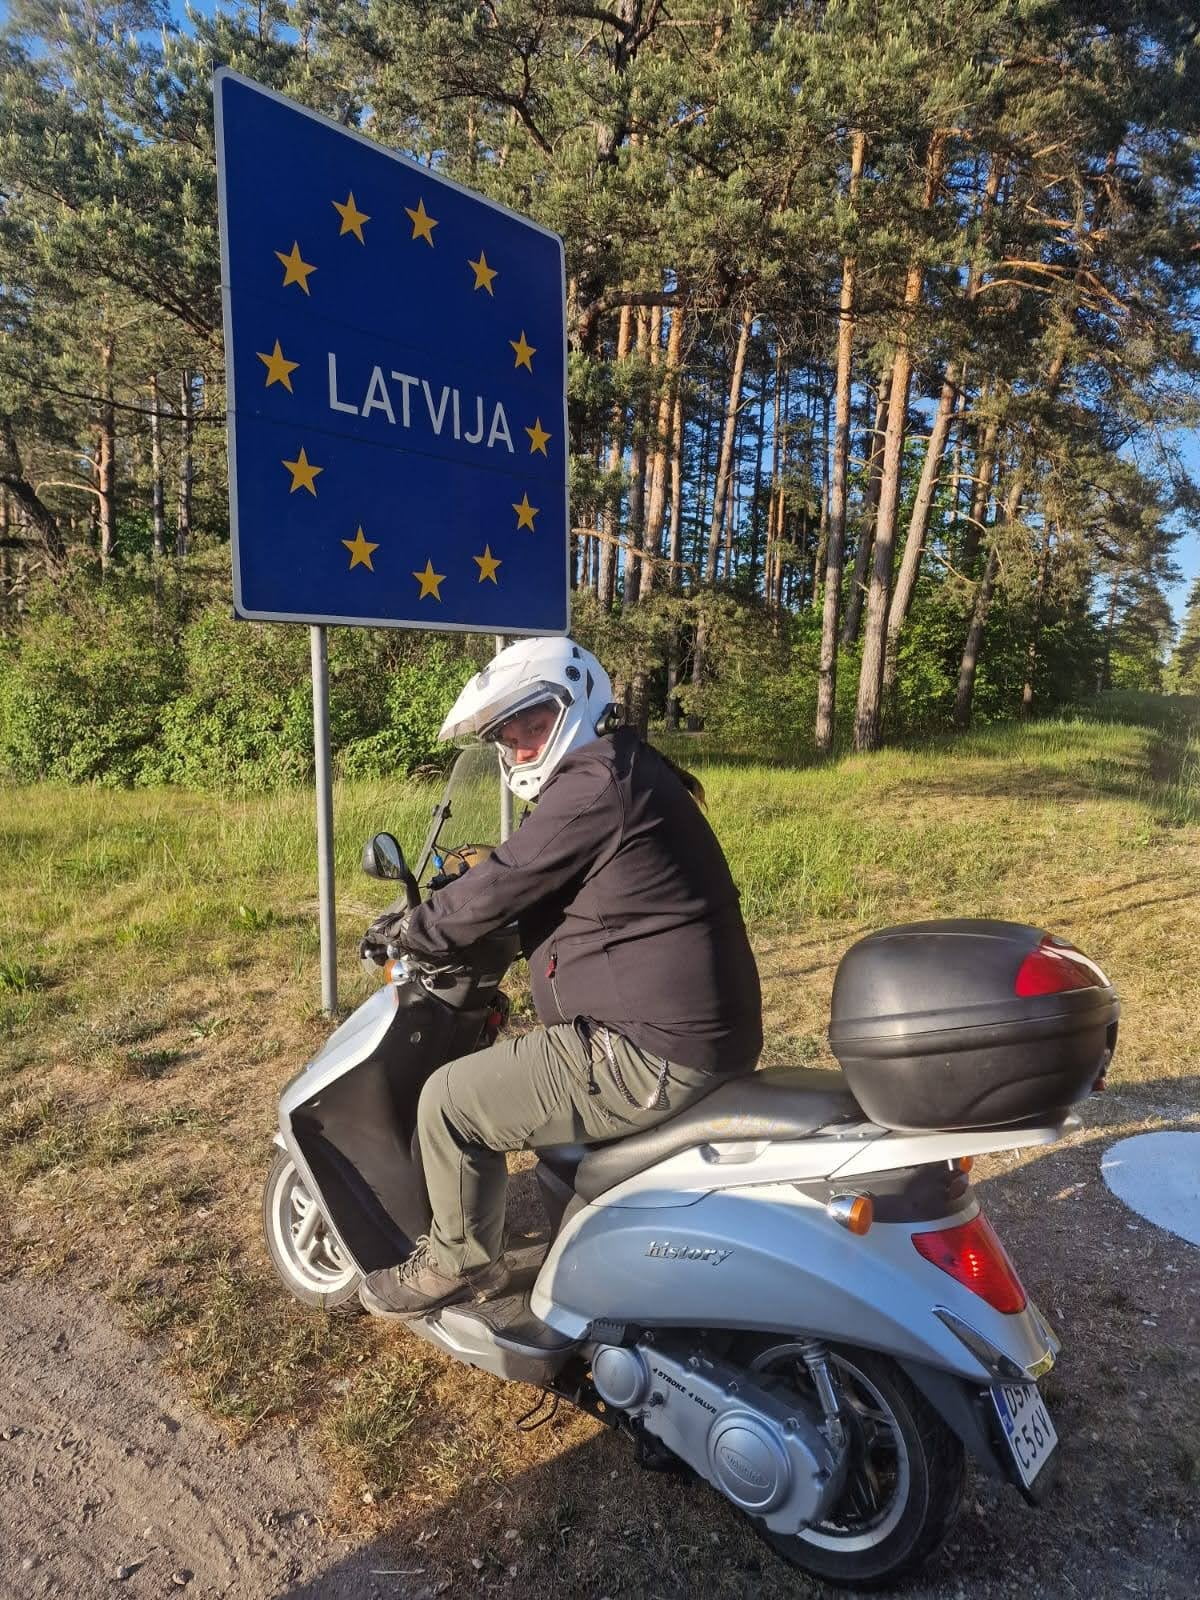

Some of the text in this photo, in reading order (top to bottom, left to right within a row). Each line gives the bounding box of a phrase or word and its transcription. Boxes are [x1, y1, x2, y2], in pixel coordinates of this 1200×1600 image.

[328, 352, 515, 453] LATVIJA
[645, 1241, 735, 1266] history
[652, 1367, 658, 1375] 4
[658, 1370, 687, 1394] STROKE
[694, 1395, 718, 1415] VALVE
[1015, 1405, 1051, 1469] C56V
